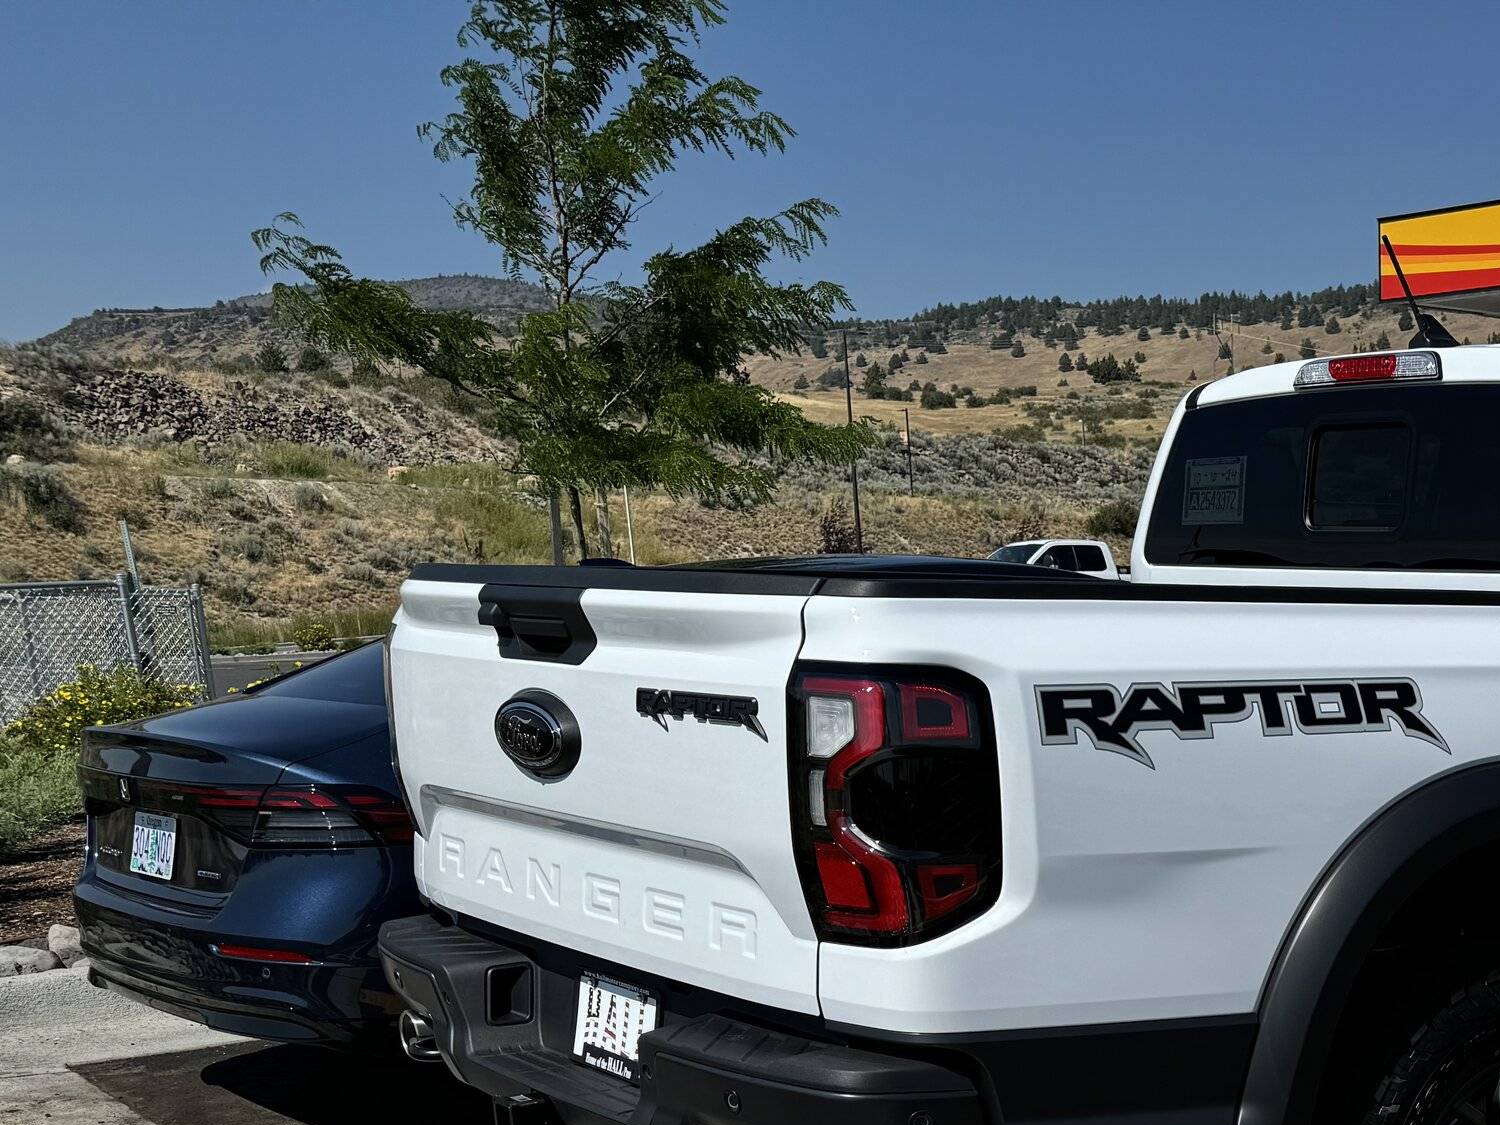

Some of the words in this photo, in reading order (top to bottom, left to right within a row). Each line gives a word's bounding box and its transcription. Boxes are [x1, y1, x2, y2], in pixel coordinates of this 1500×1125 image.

[636, 686, 769, 743] RAPTOR
[1034, 677, 1452, 770] RAPTOR
[439, 832, 758, 960] RANGER
[607, 1056, 624, 1076] HALL
